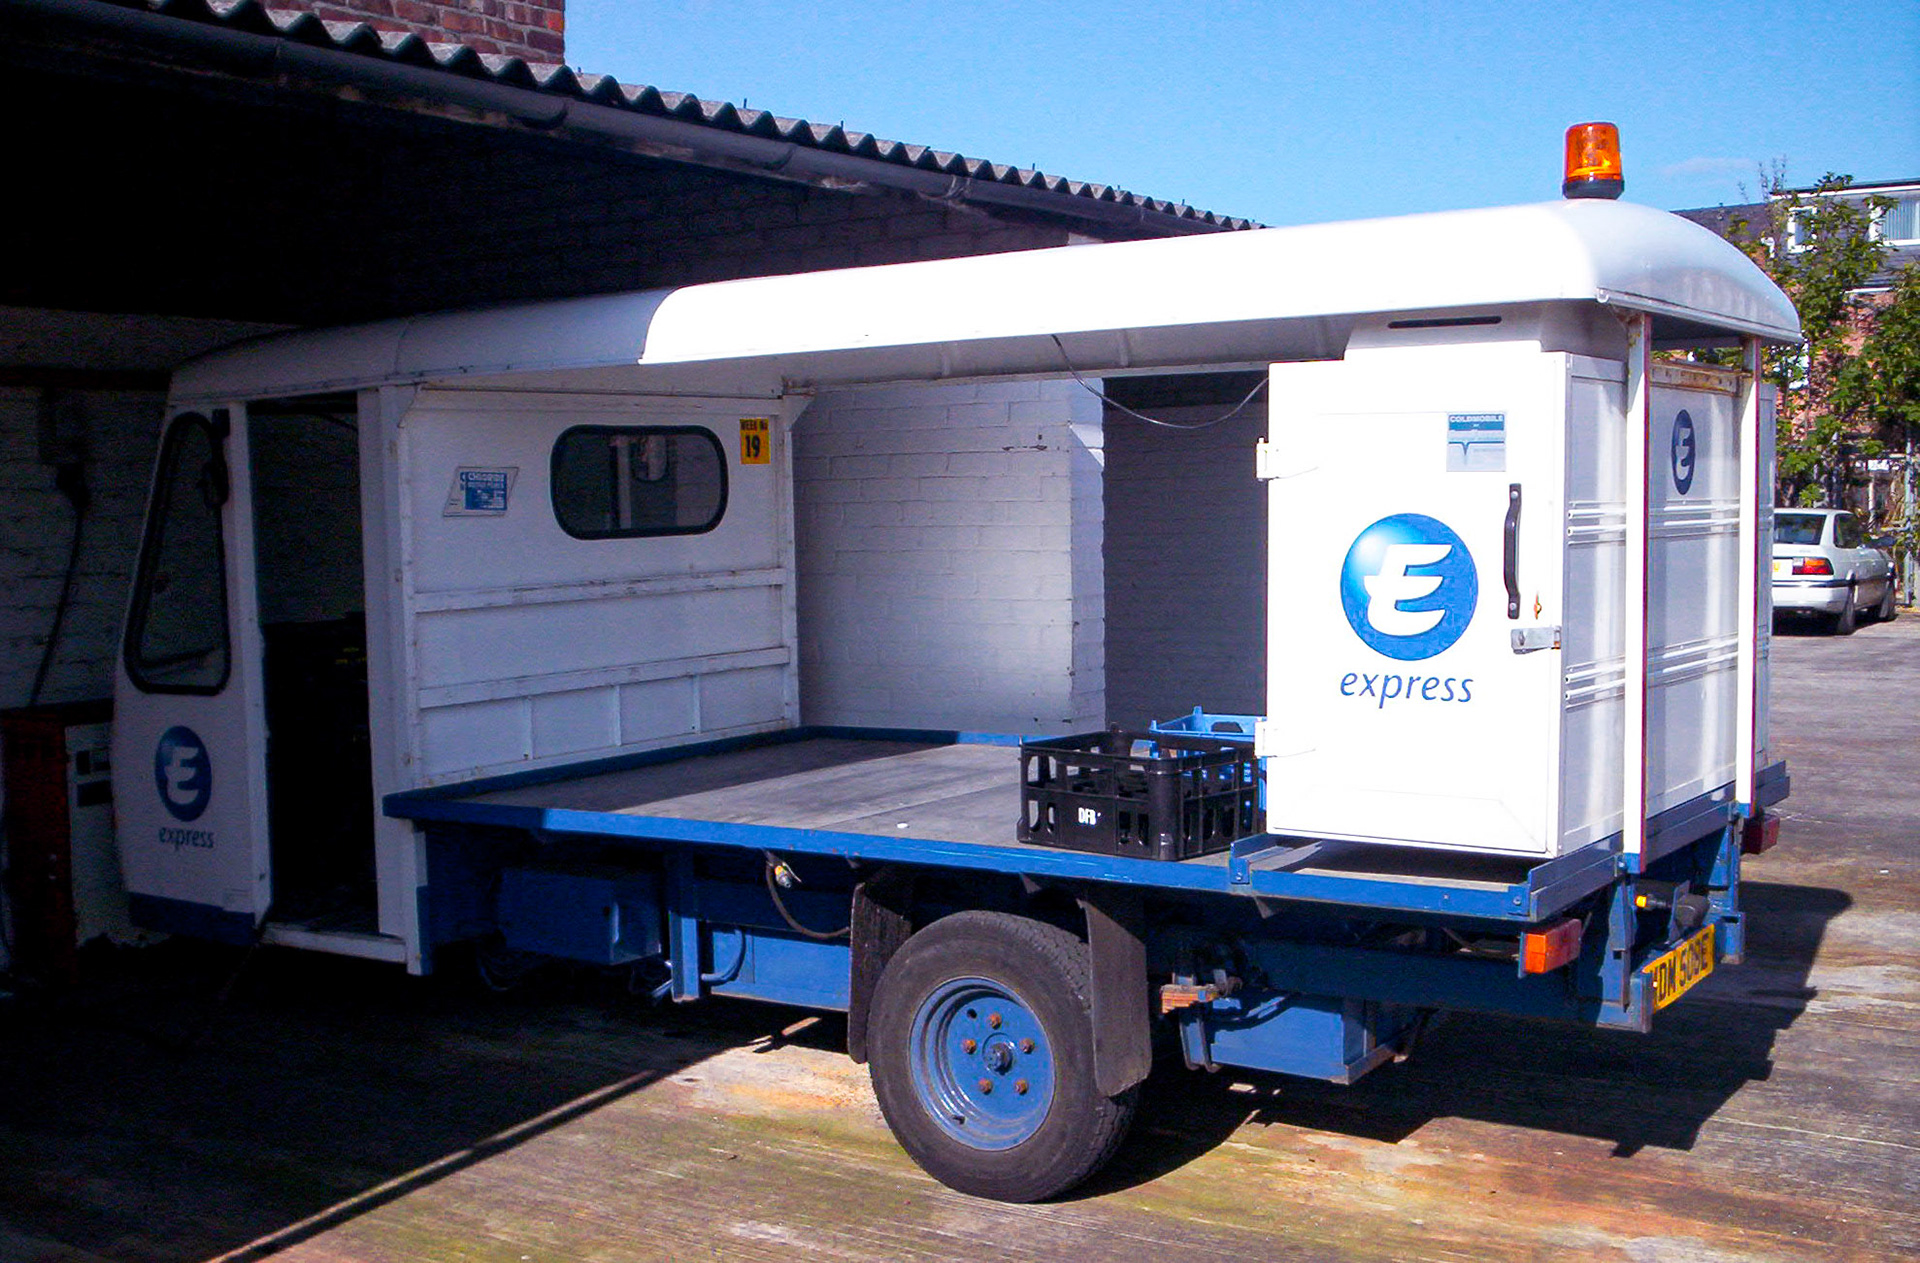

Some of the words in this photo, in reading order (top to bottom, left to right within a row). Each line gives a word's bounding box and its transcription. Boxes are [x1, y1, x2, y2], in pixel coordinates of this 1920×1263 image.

[745, 434, 760, 458] 19
[1339, 671, 1475, 710] express
[158, 826, 215, 852] express
